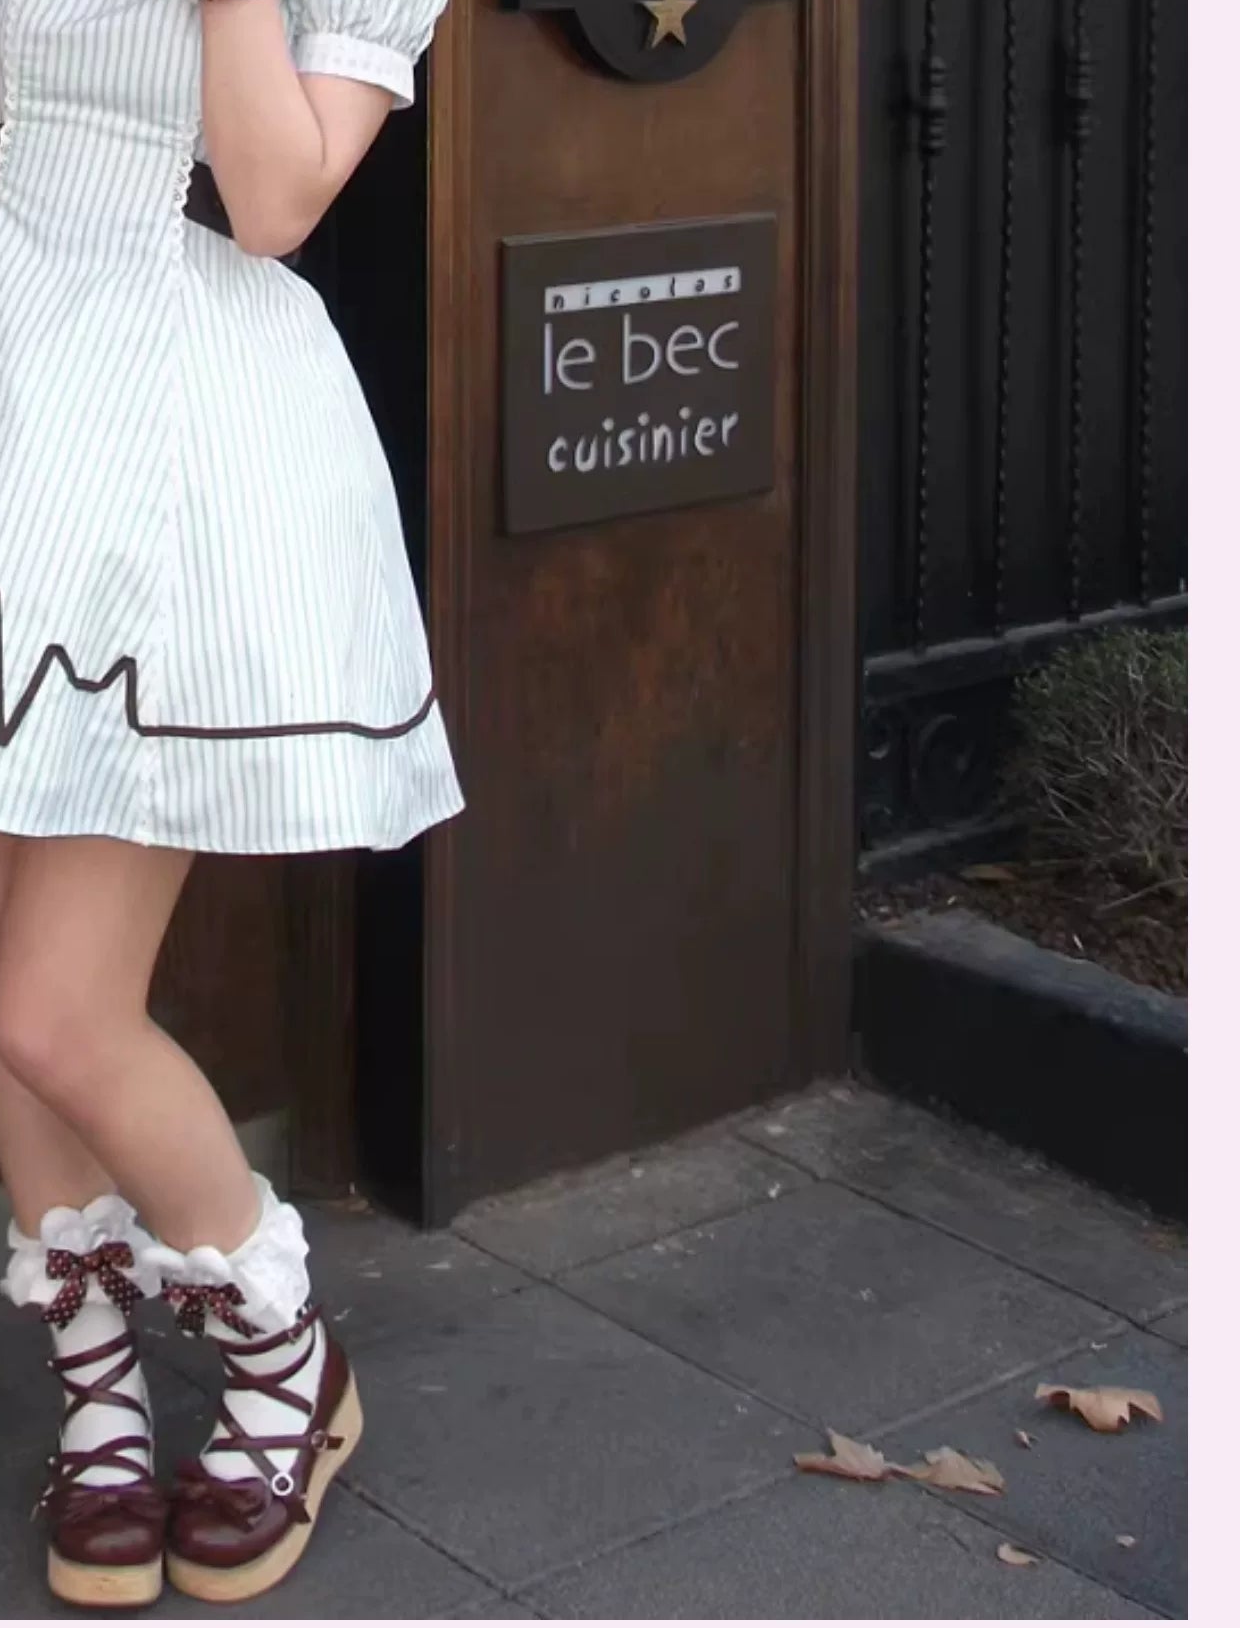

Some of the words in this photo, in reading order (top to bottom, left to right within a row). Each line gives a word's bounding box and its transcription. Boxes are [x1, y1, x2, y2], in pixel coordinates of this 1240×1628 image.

[551, 273, 734, 310] nicolas
[544, 322, 596, 395] le
[623, 312, 740, 385] bec
[548, 406, 739, 473] cuisinier
